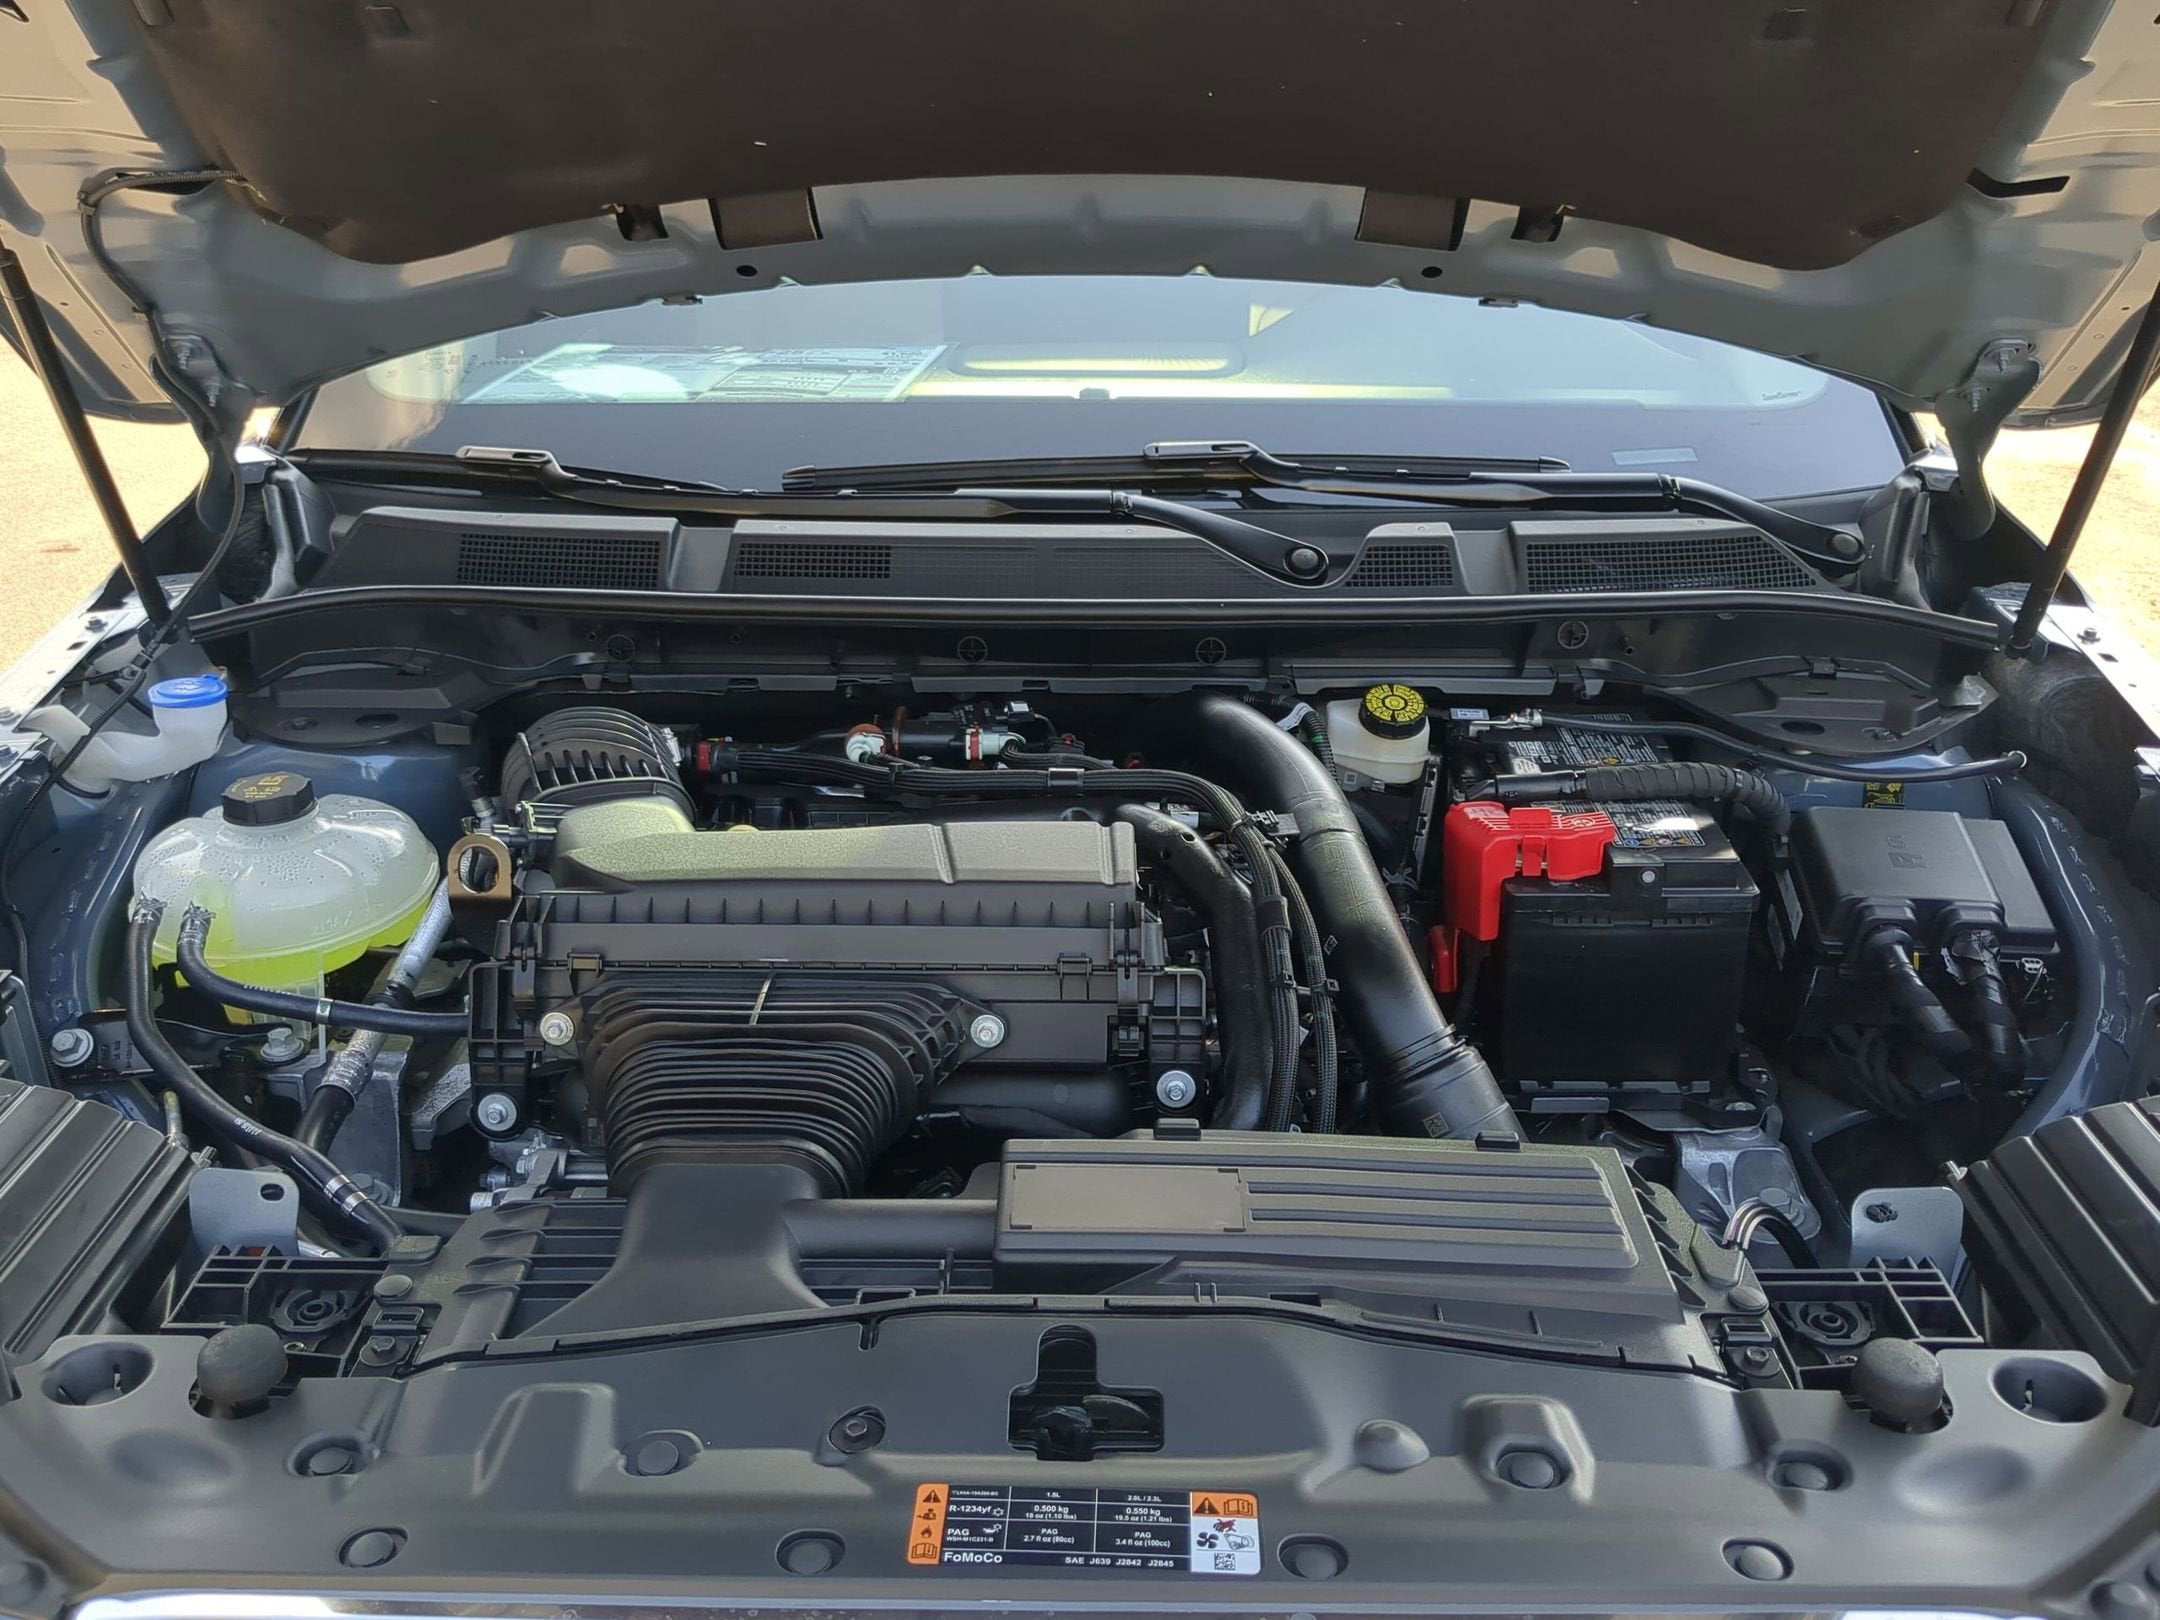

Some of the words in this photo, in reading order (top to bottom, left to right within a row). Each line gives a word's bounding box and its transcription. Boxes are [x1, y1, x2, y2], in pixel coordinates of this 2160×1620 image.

[949, 1505, 991, 1513] R-1234yf
[1058, 1505, 1069, 1514] kg
[1126, 1507, 1149, 1515] 0.550
[1149, 1508, 1161, 1517] kg
[1158, 1515, 1173, 1523] lbs)
[947, 1528, 970, 1536] PAG
[1144, 1539, 1171, 1548] (100cc)
[944, 1553, 1003, 1563] FoMoCo
[1065, 1556, 1085, 1565] SAE
[1089, 1558, 1111, 1566] J639
